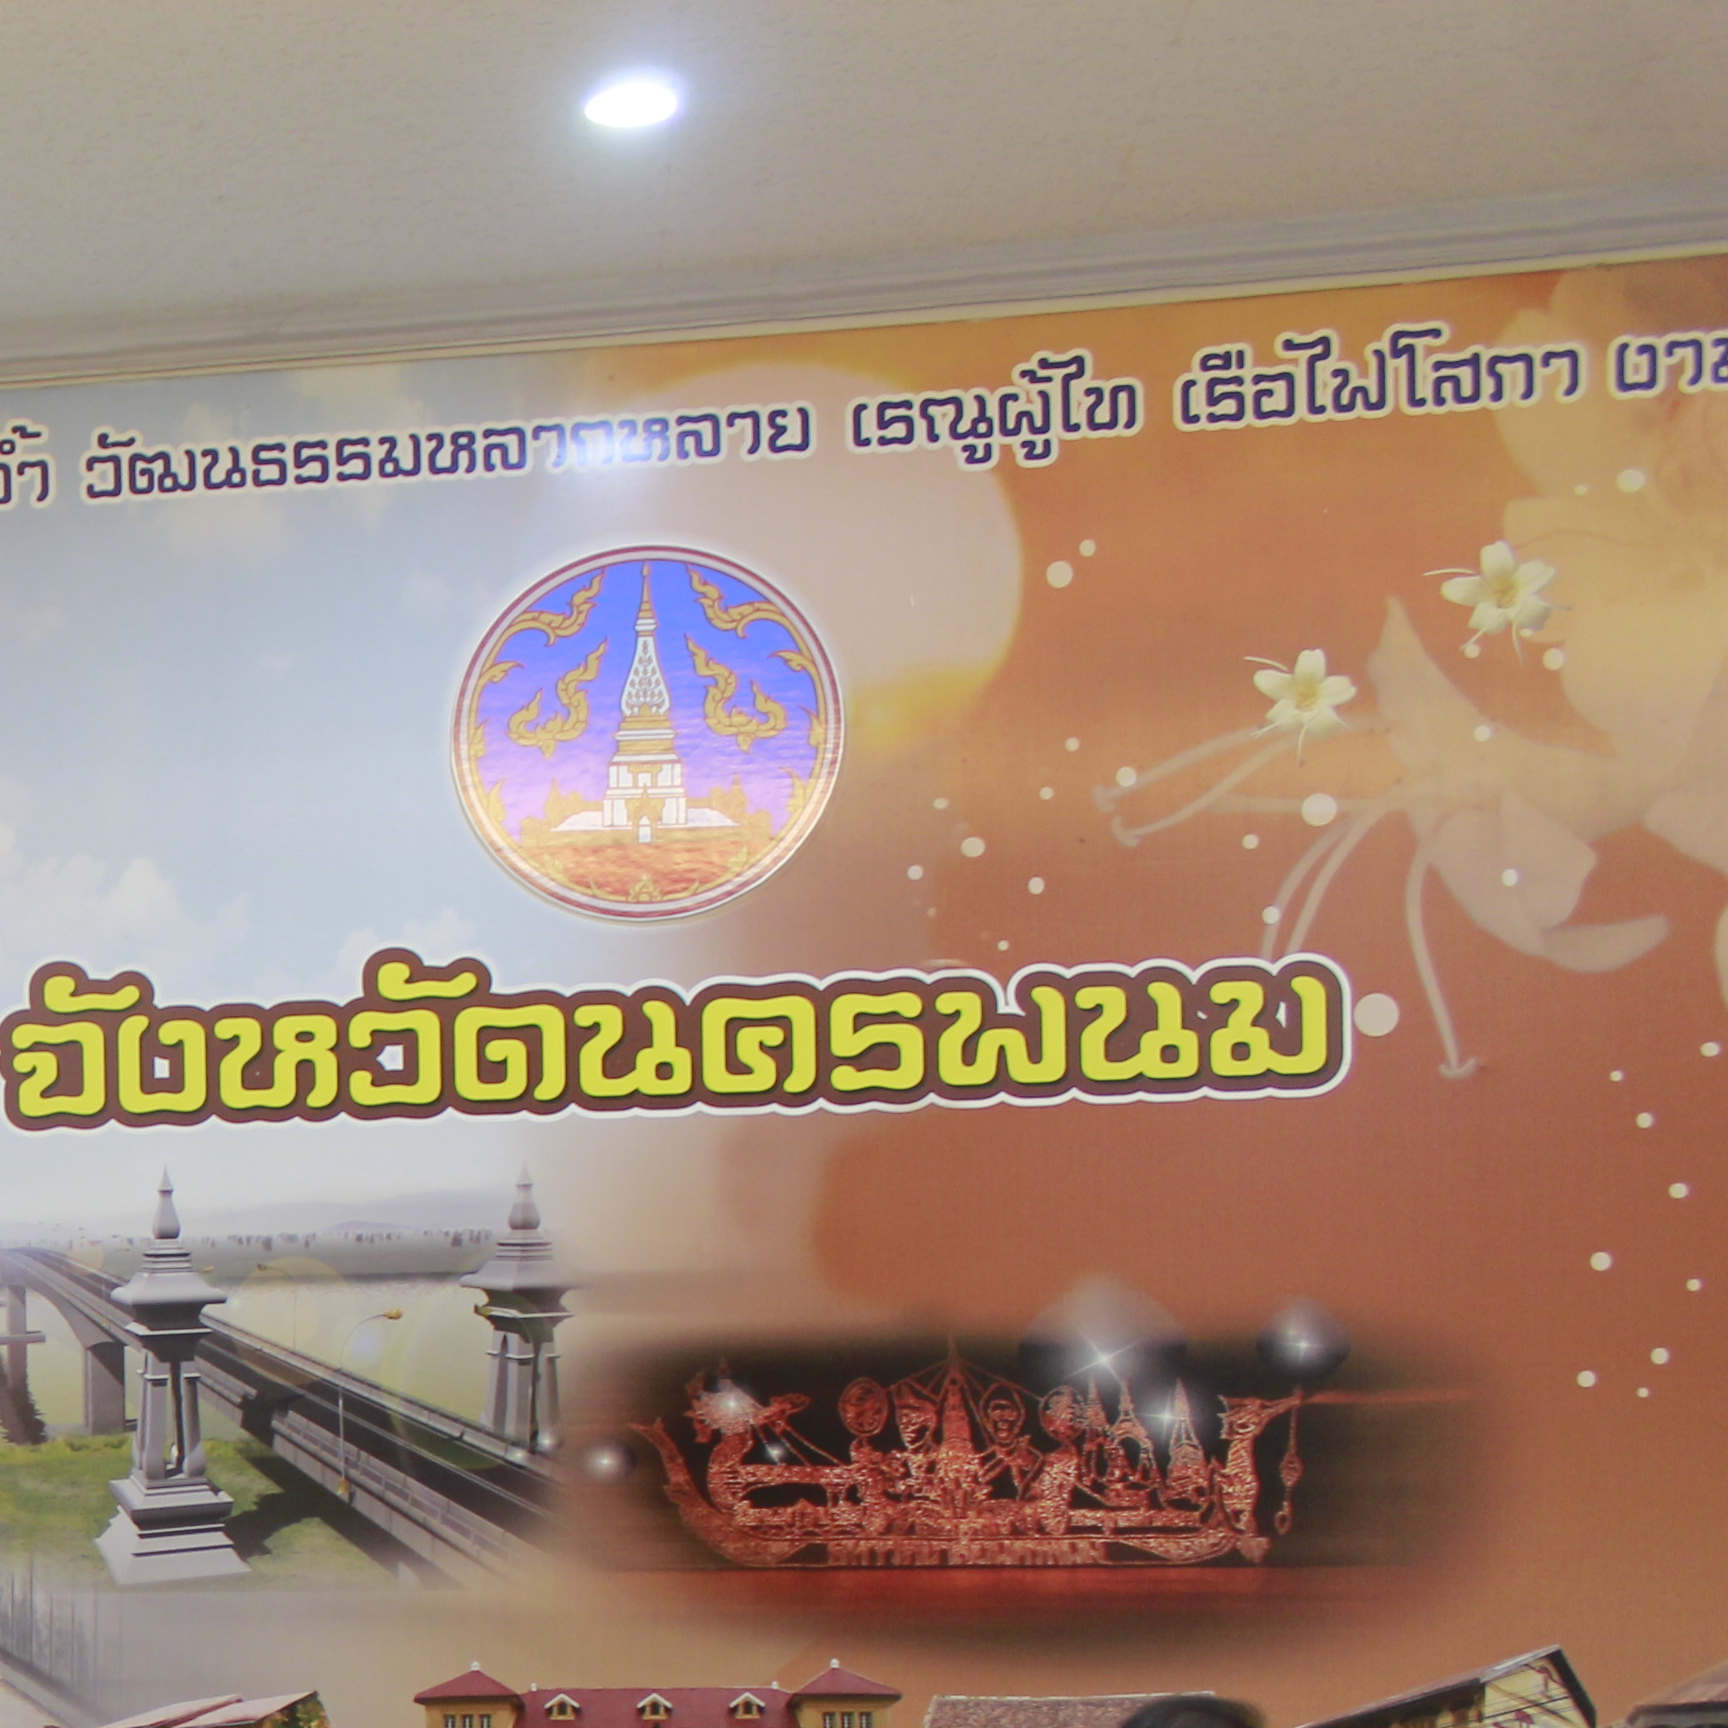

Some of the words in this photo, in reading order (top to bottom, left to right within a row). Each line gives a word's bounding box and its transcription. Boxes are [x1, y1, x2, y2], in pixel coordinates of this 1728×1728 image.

[850, 353, 1138, 466] เรณูผู้ไท
[1178, 326, 1581, 426] เรือไฟโสภา
[4, 957, 1339, 1123] จังหวัดนครพนม
